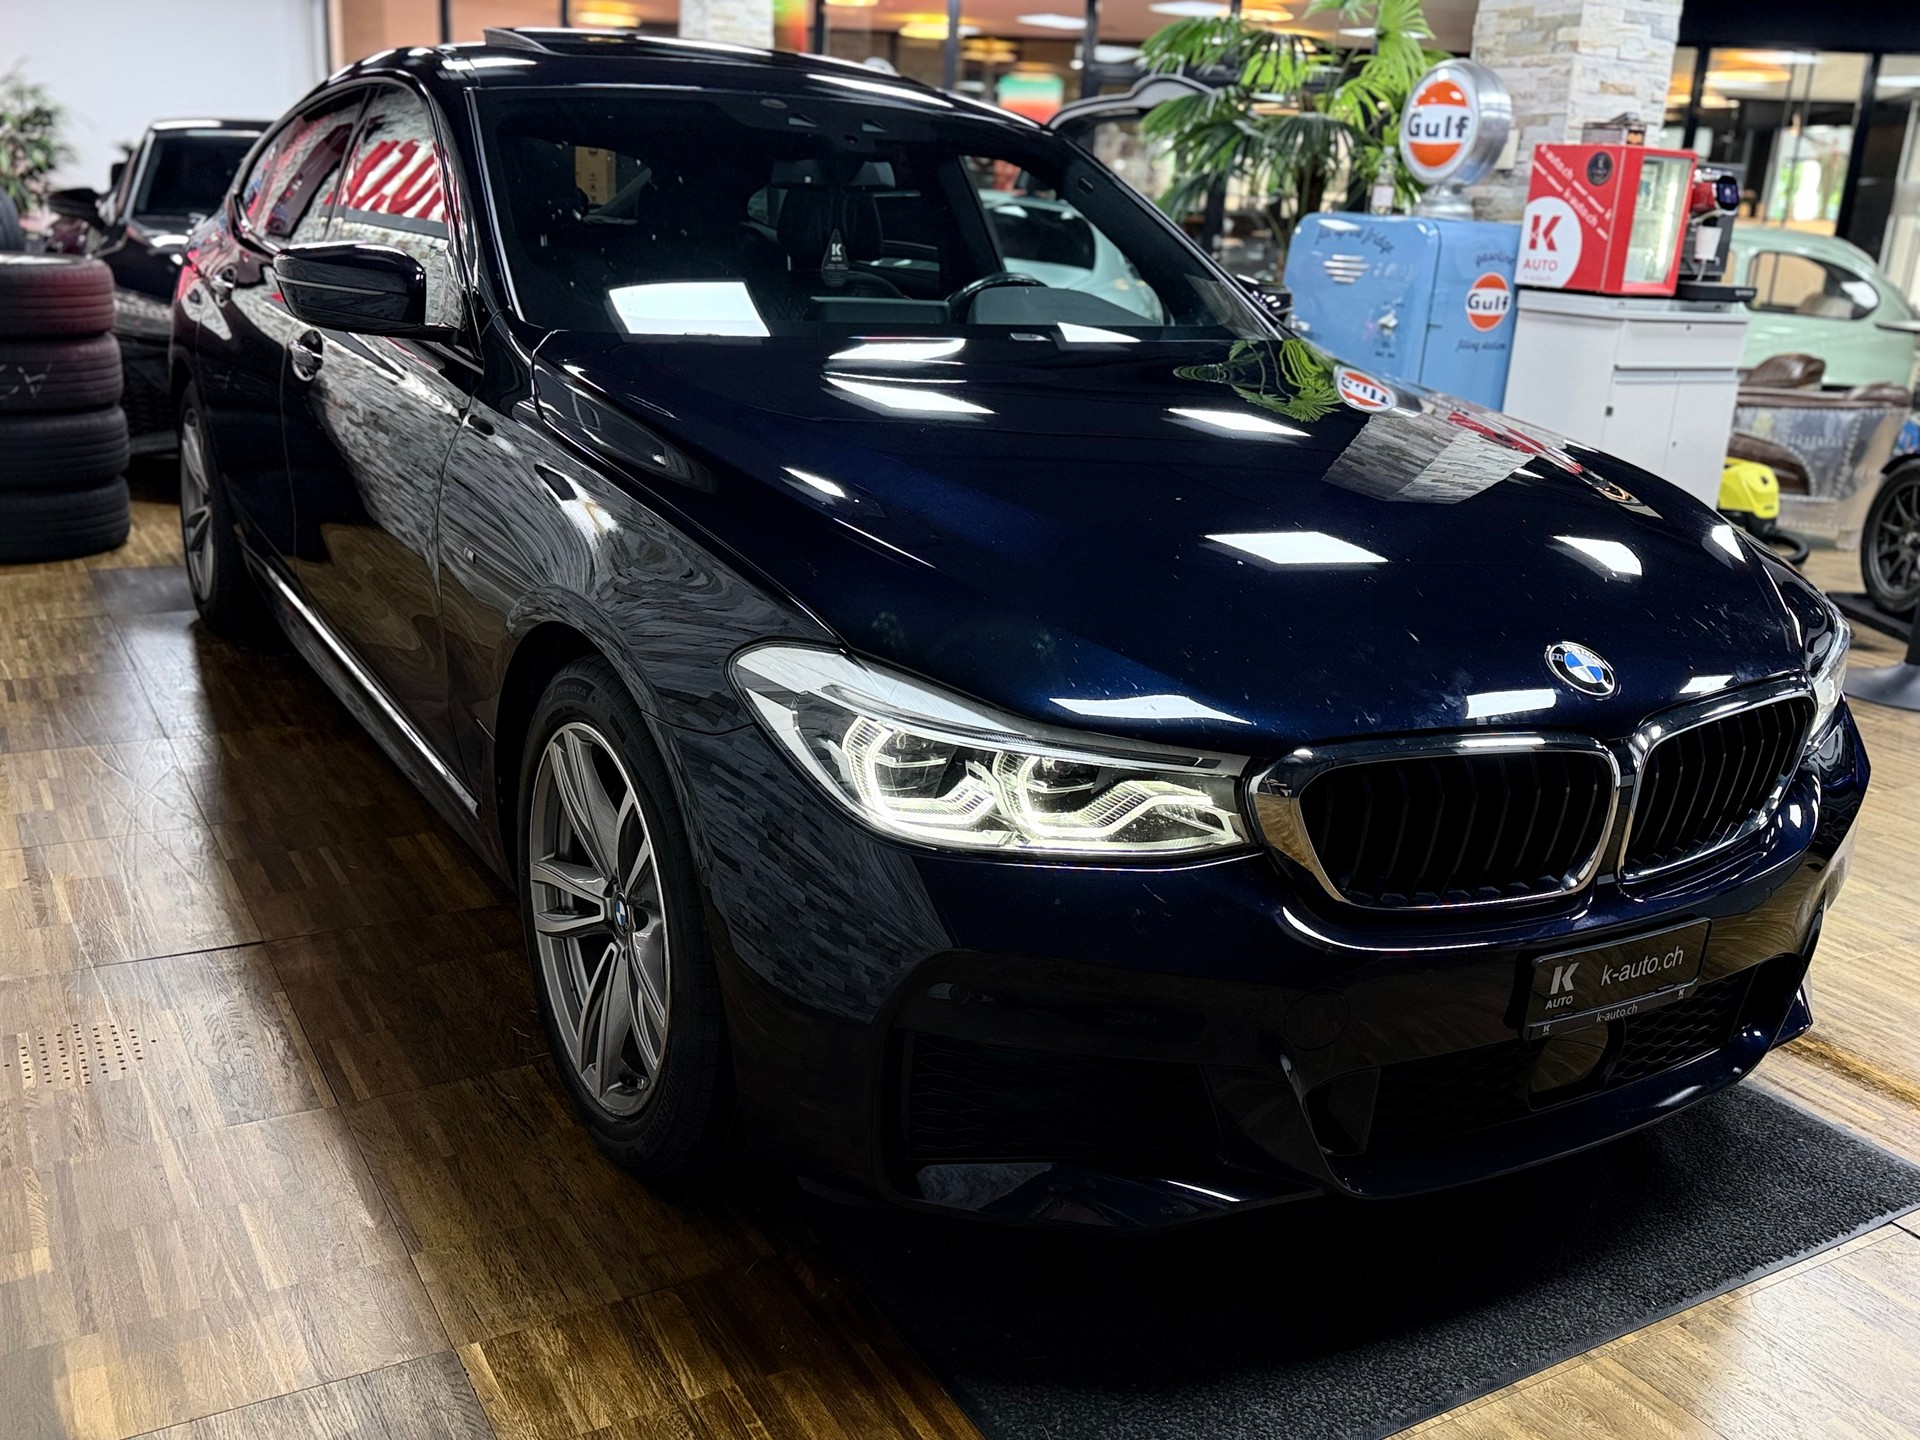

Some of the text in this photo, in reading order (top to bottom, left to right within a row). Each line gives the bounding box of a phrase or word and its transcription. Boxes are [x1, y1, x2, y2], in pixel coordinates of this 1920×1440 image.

[1407, 112, 1469, 138] Gulf
[1529, 214, 1562, 252] K
[831, 243, 842, 256] K
[1523, 258, 1558, 272] AUTO
[1467, 293, 1510, 311] Gulf
[1600, 945, 1684, 986] k-auto.ch
[1550, 962, 1580, 995] K
[1545, 995, 1574, 1010] AUTO
[1596, 1003, 1638, 1023] k-auto.ch
